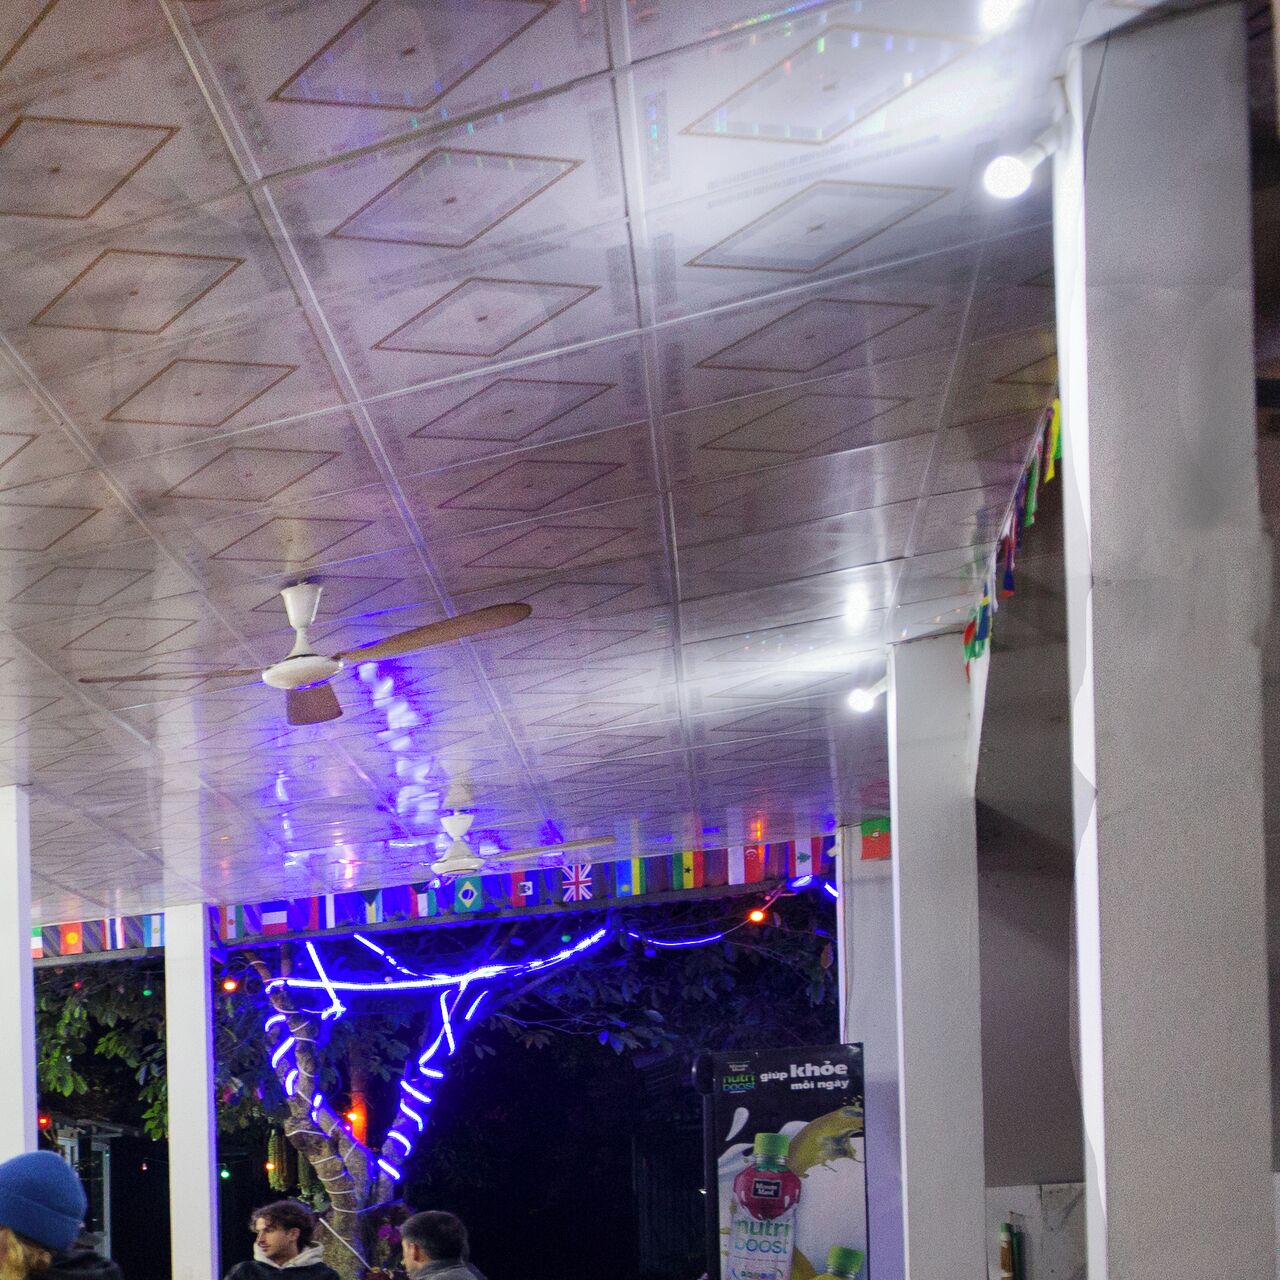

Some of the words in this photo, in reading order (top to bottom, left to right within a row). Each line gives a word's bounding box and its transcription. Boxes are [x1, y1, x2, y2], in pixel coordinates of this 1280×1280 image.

[790, 1060, 849, 1078] khỏe
[735, 1217, 791, 1237] nutri
[733, 1236, 790, 1255] boost
